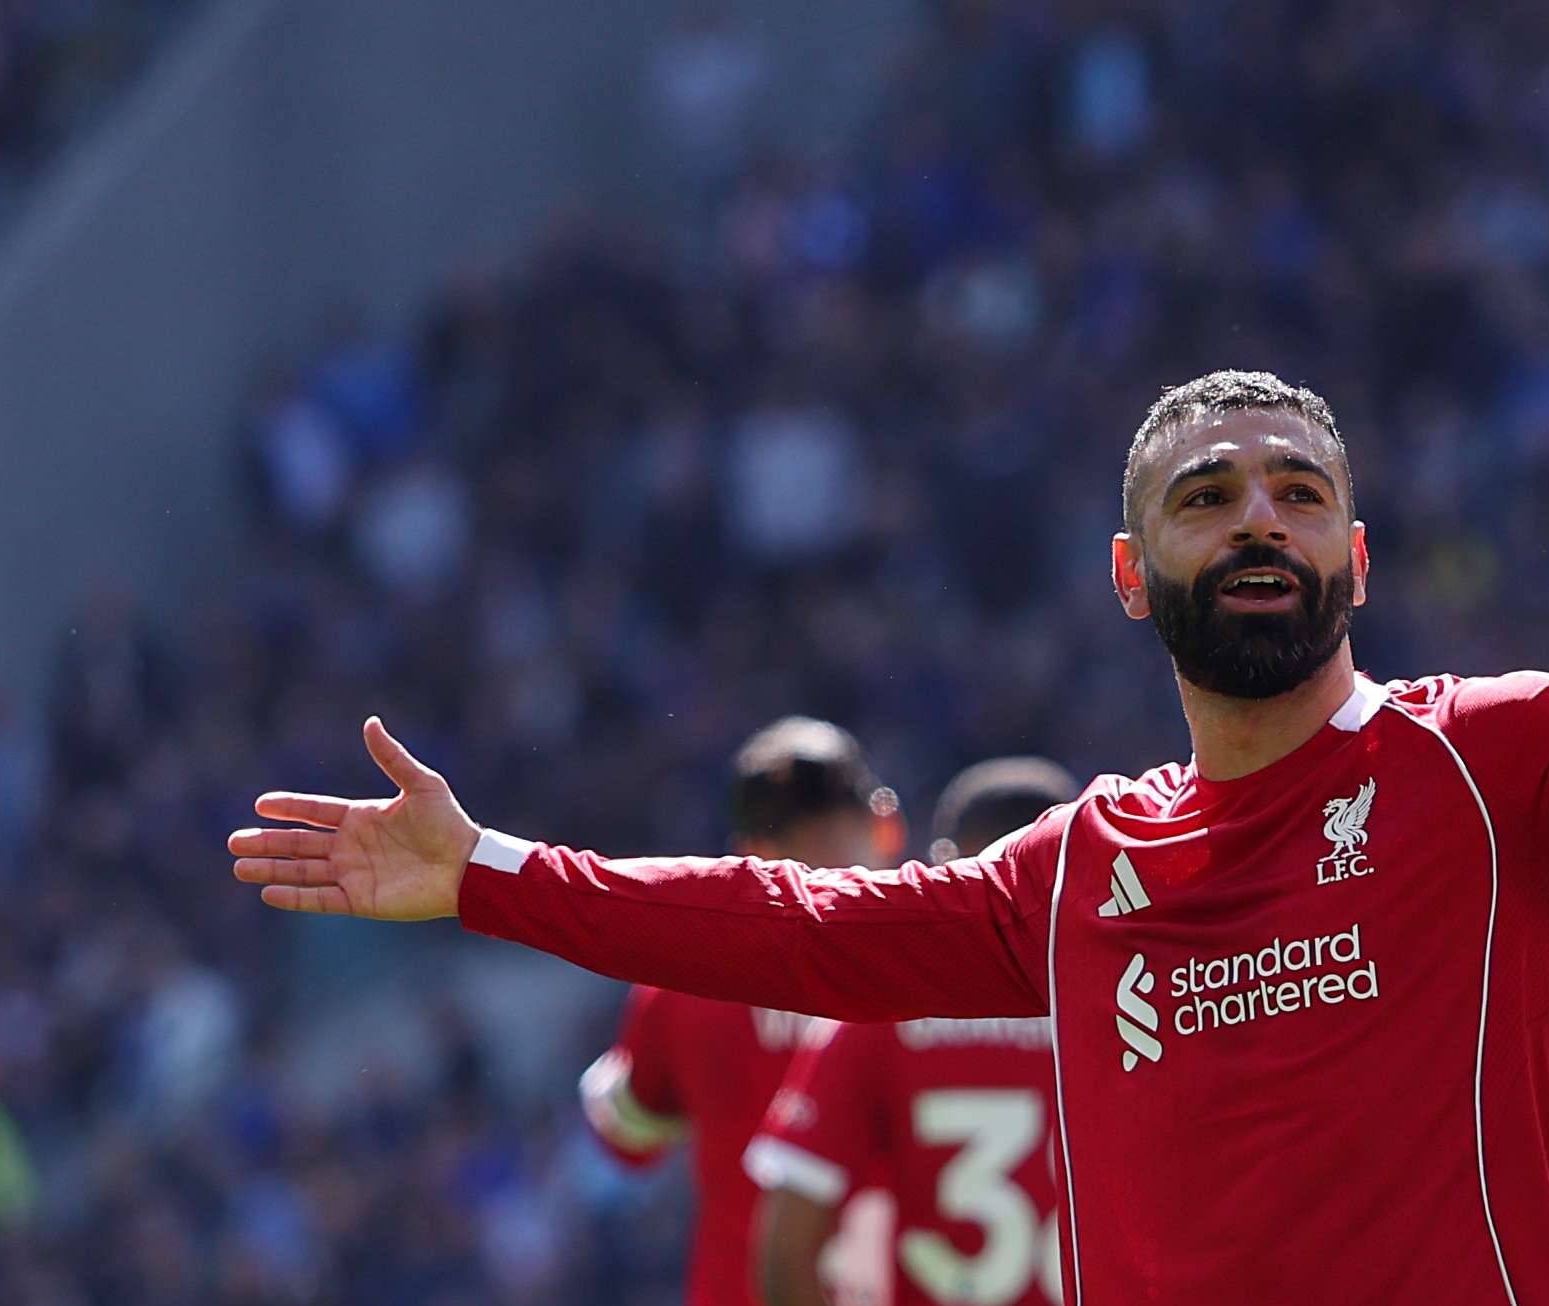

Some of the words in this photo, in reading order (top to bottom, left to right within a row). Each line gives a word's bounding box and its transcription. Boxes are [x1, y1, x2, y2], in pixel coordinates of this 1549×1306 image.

[1316, 855, 1375, 885] L.F.C.
[1170, 923, 1361, 998] standard
[1174, 961, 1378, 1036] chartered
